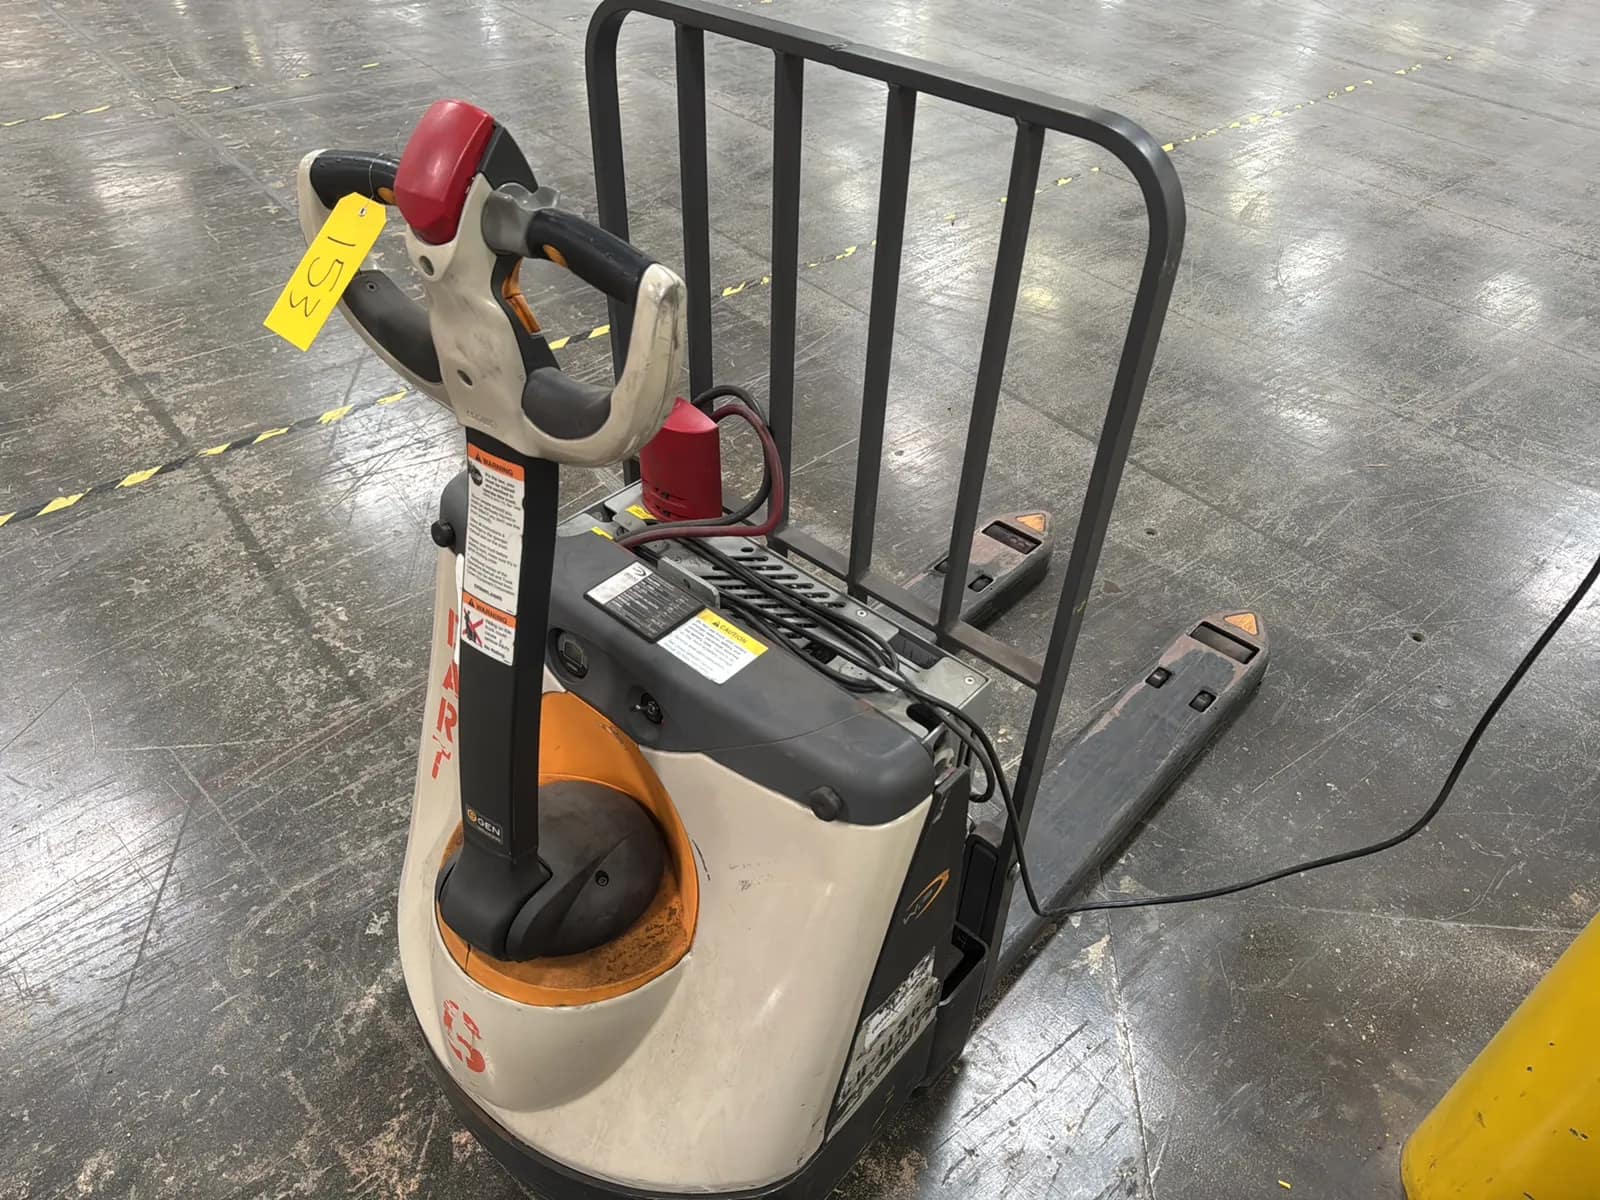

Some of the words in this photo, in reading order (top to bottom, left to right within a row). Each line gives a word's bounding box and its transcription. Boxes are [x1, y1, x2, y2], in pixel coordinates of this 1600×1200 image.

[289, 236, 356, 318] 153
[476, 603, 507, 624] WARNING
[719, 624, 747, 644] CAUTION
